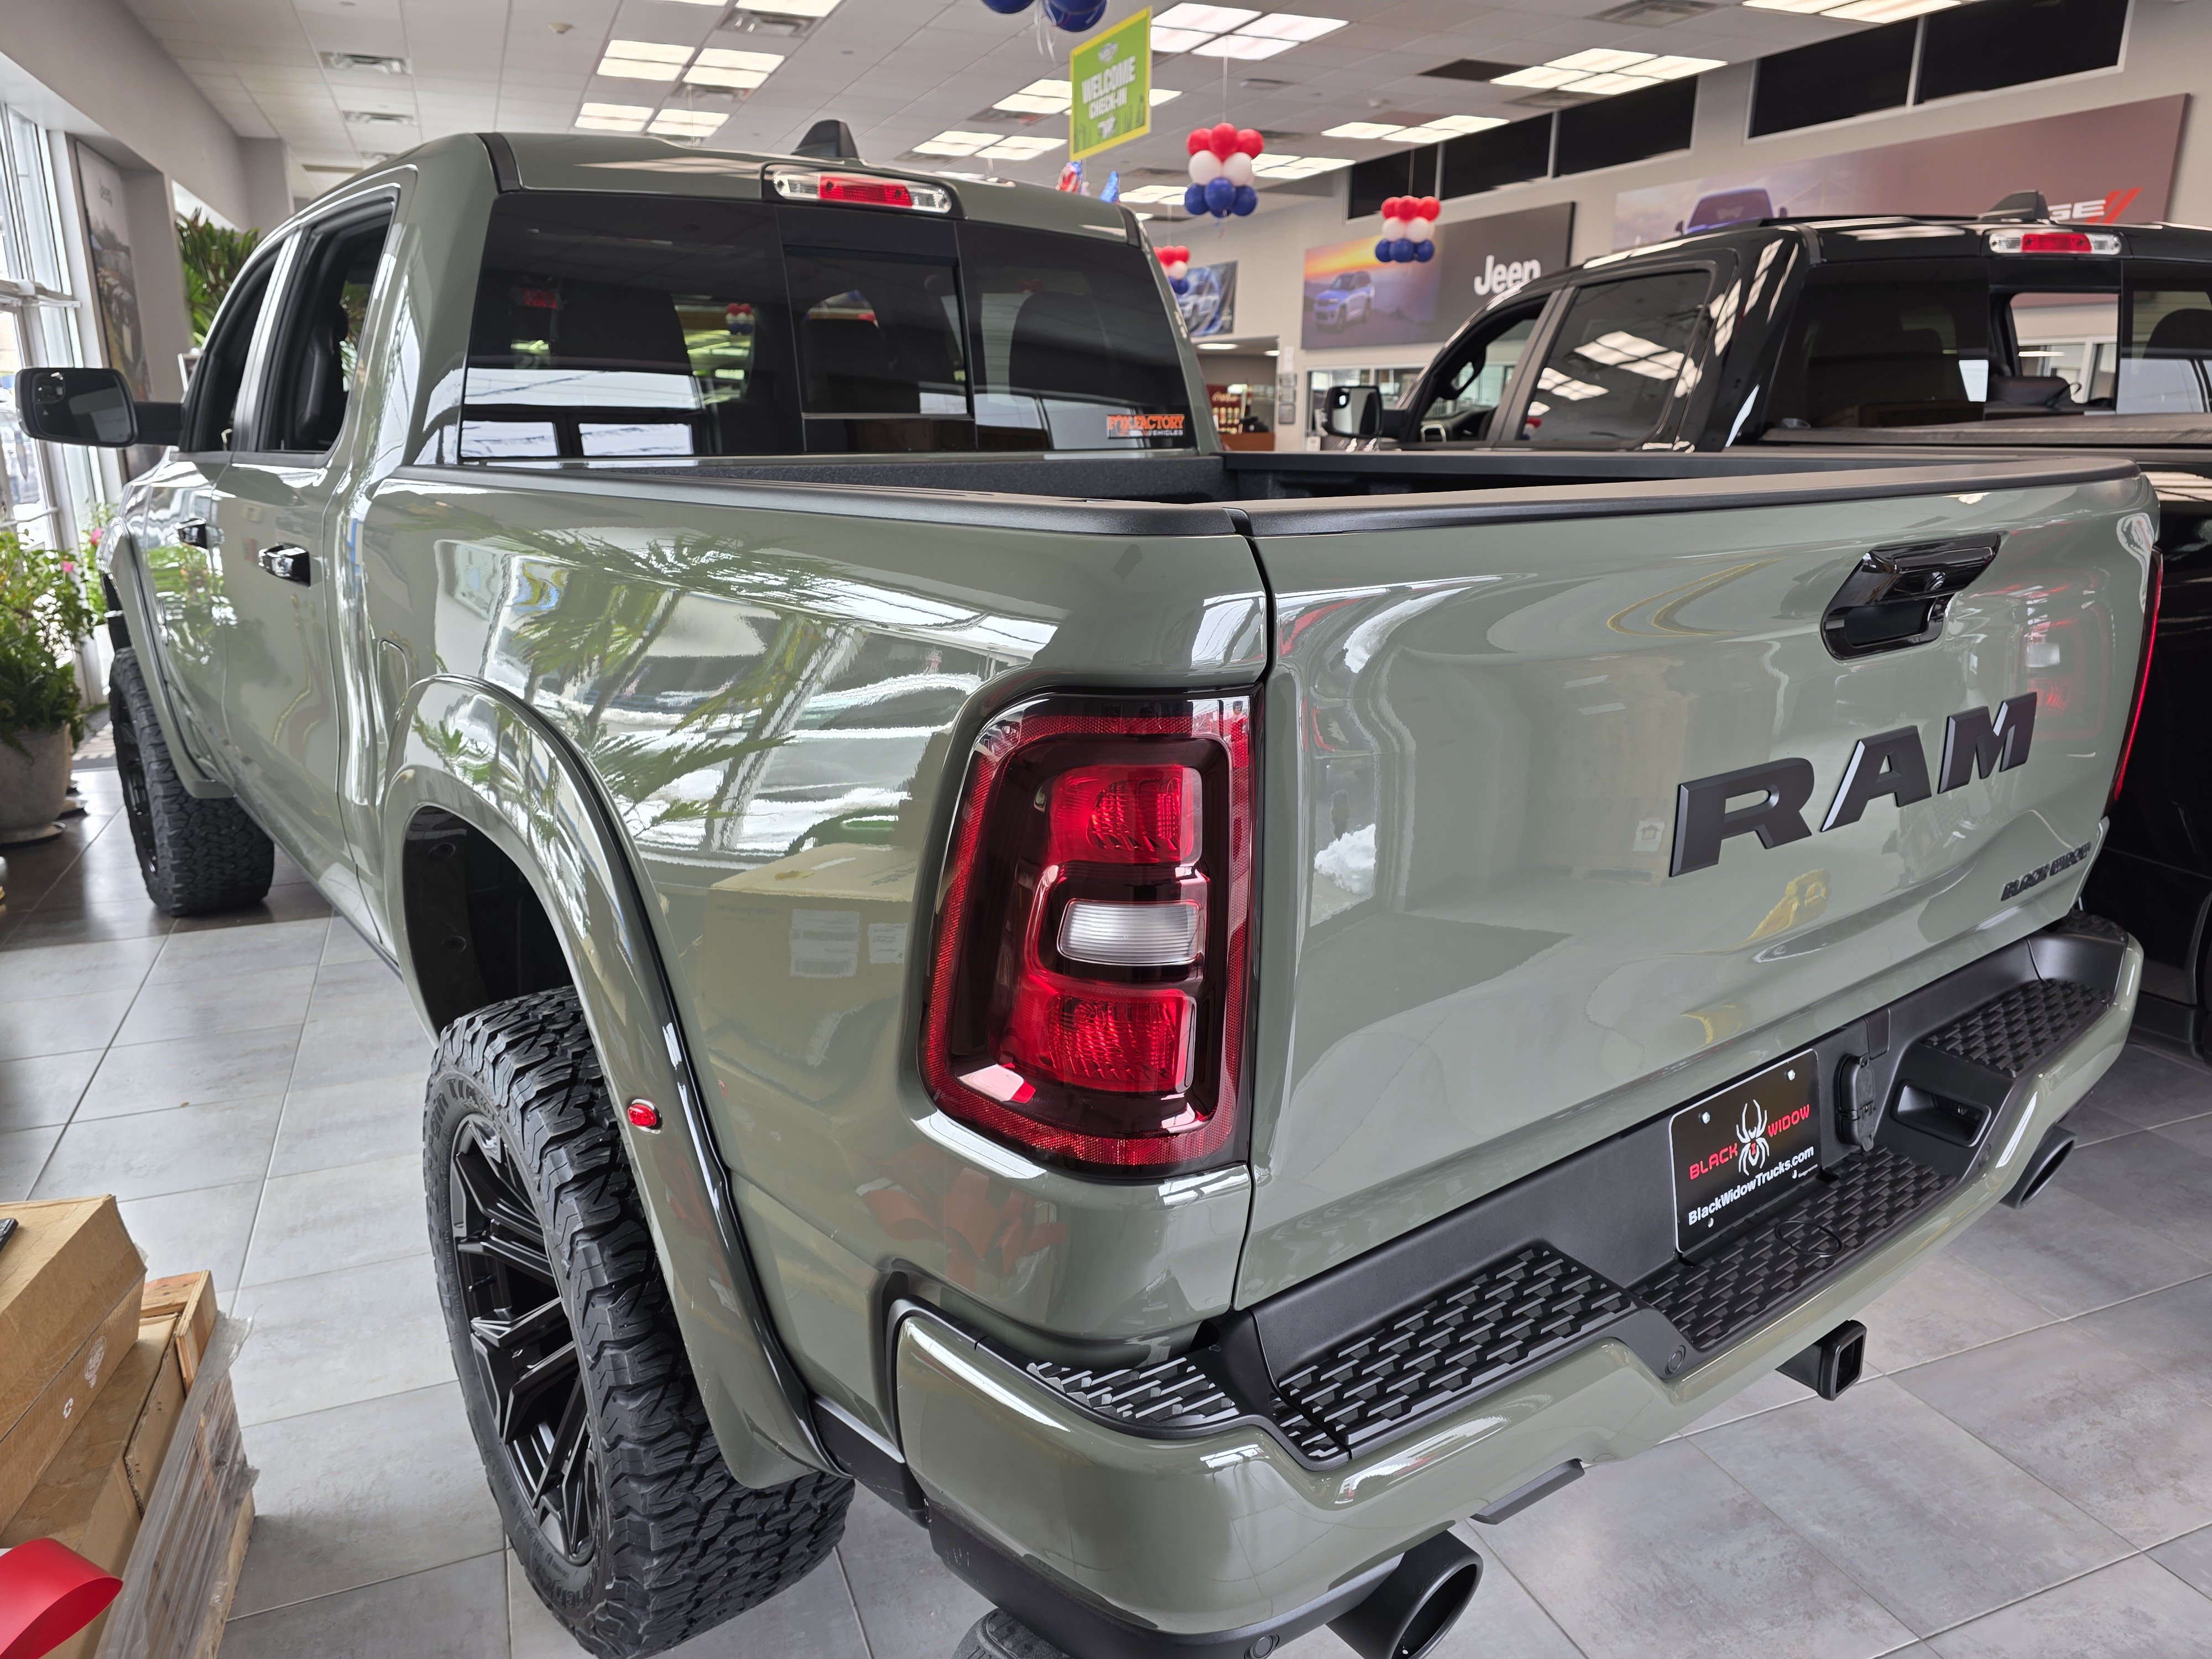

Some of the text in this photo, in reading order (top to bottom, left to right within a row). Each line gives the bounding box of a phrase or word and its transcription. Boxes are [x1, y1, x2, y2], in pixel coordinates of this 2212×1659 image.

[1082, 56, 1135, 104] WELCOME
[1089, 86, 1127, 119] CHECK-IN
[1108, 415, 1184, 434] FOX FACTORY
[1669, 692, 2037, 877] RAM
[1690, 1105, 1810, 1180] BLACK WIDOW
[1688, 1146, 1814, 1225] BlackWidowTrucks.com
